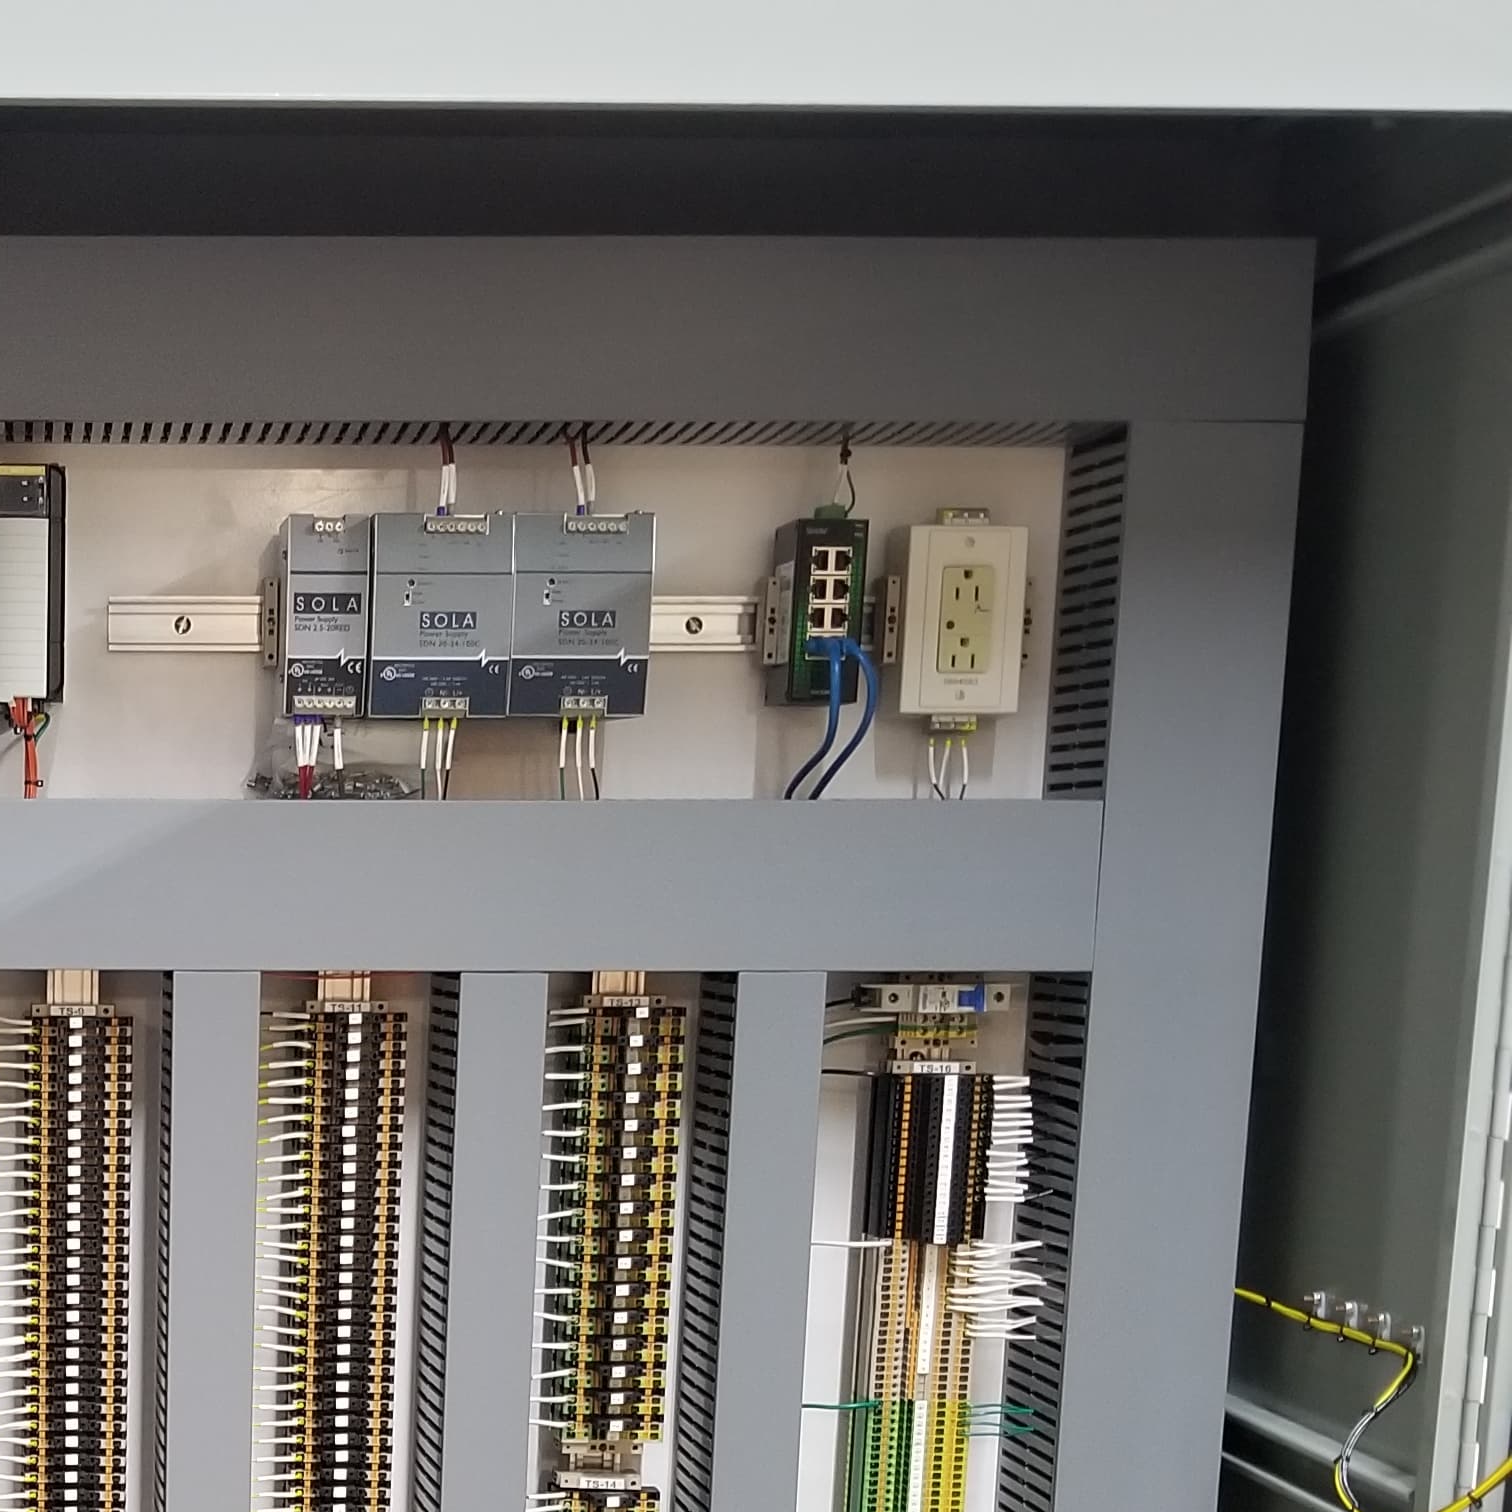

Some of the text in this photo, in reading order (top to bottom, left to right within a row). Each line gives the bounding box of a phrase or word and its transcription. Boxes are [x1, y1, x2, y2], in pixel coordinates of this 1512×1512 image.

[295, 596, 359, 612] SOLA
[420, 612, 475, 628] SOLA
[560, 611, 614, 627] SOLA
[584, 1480, 617, 1488] TS-14
